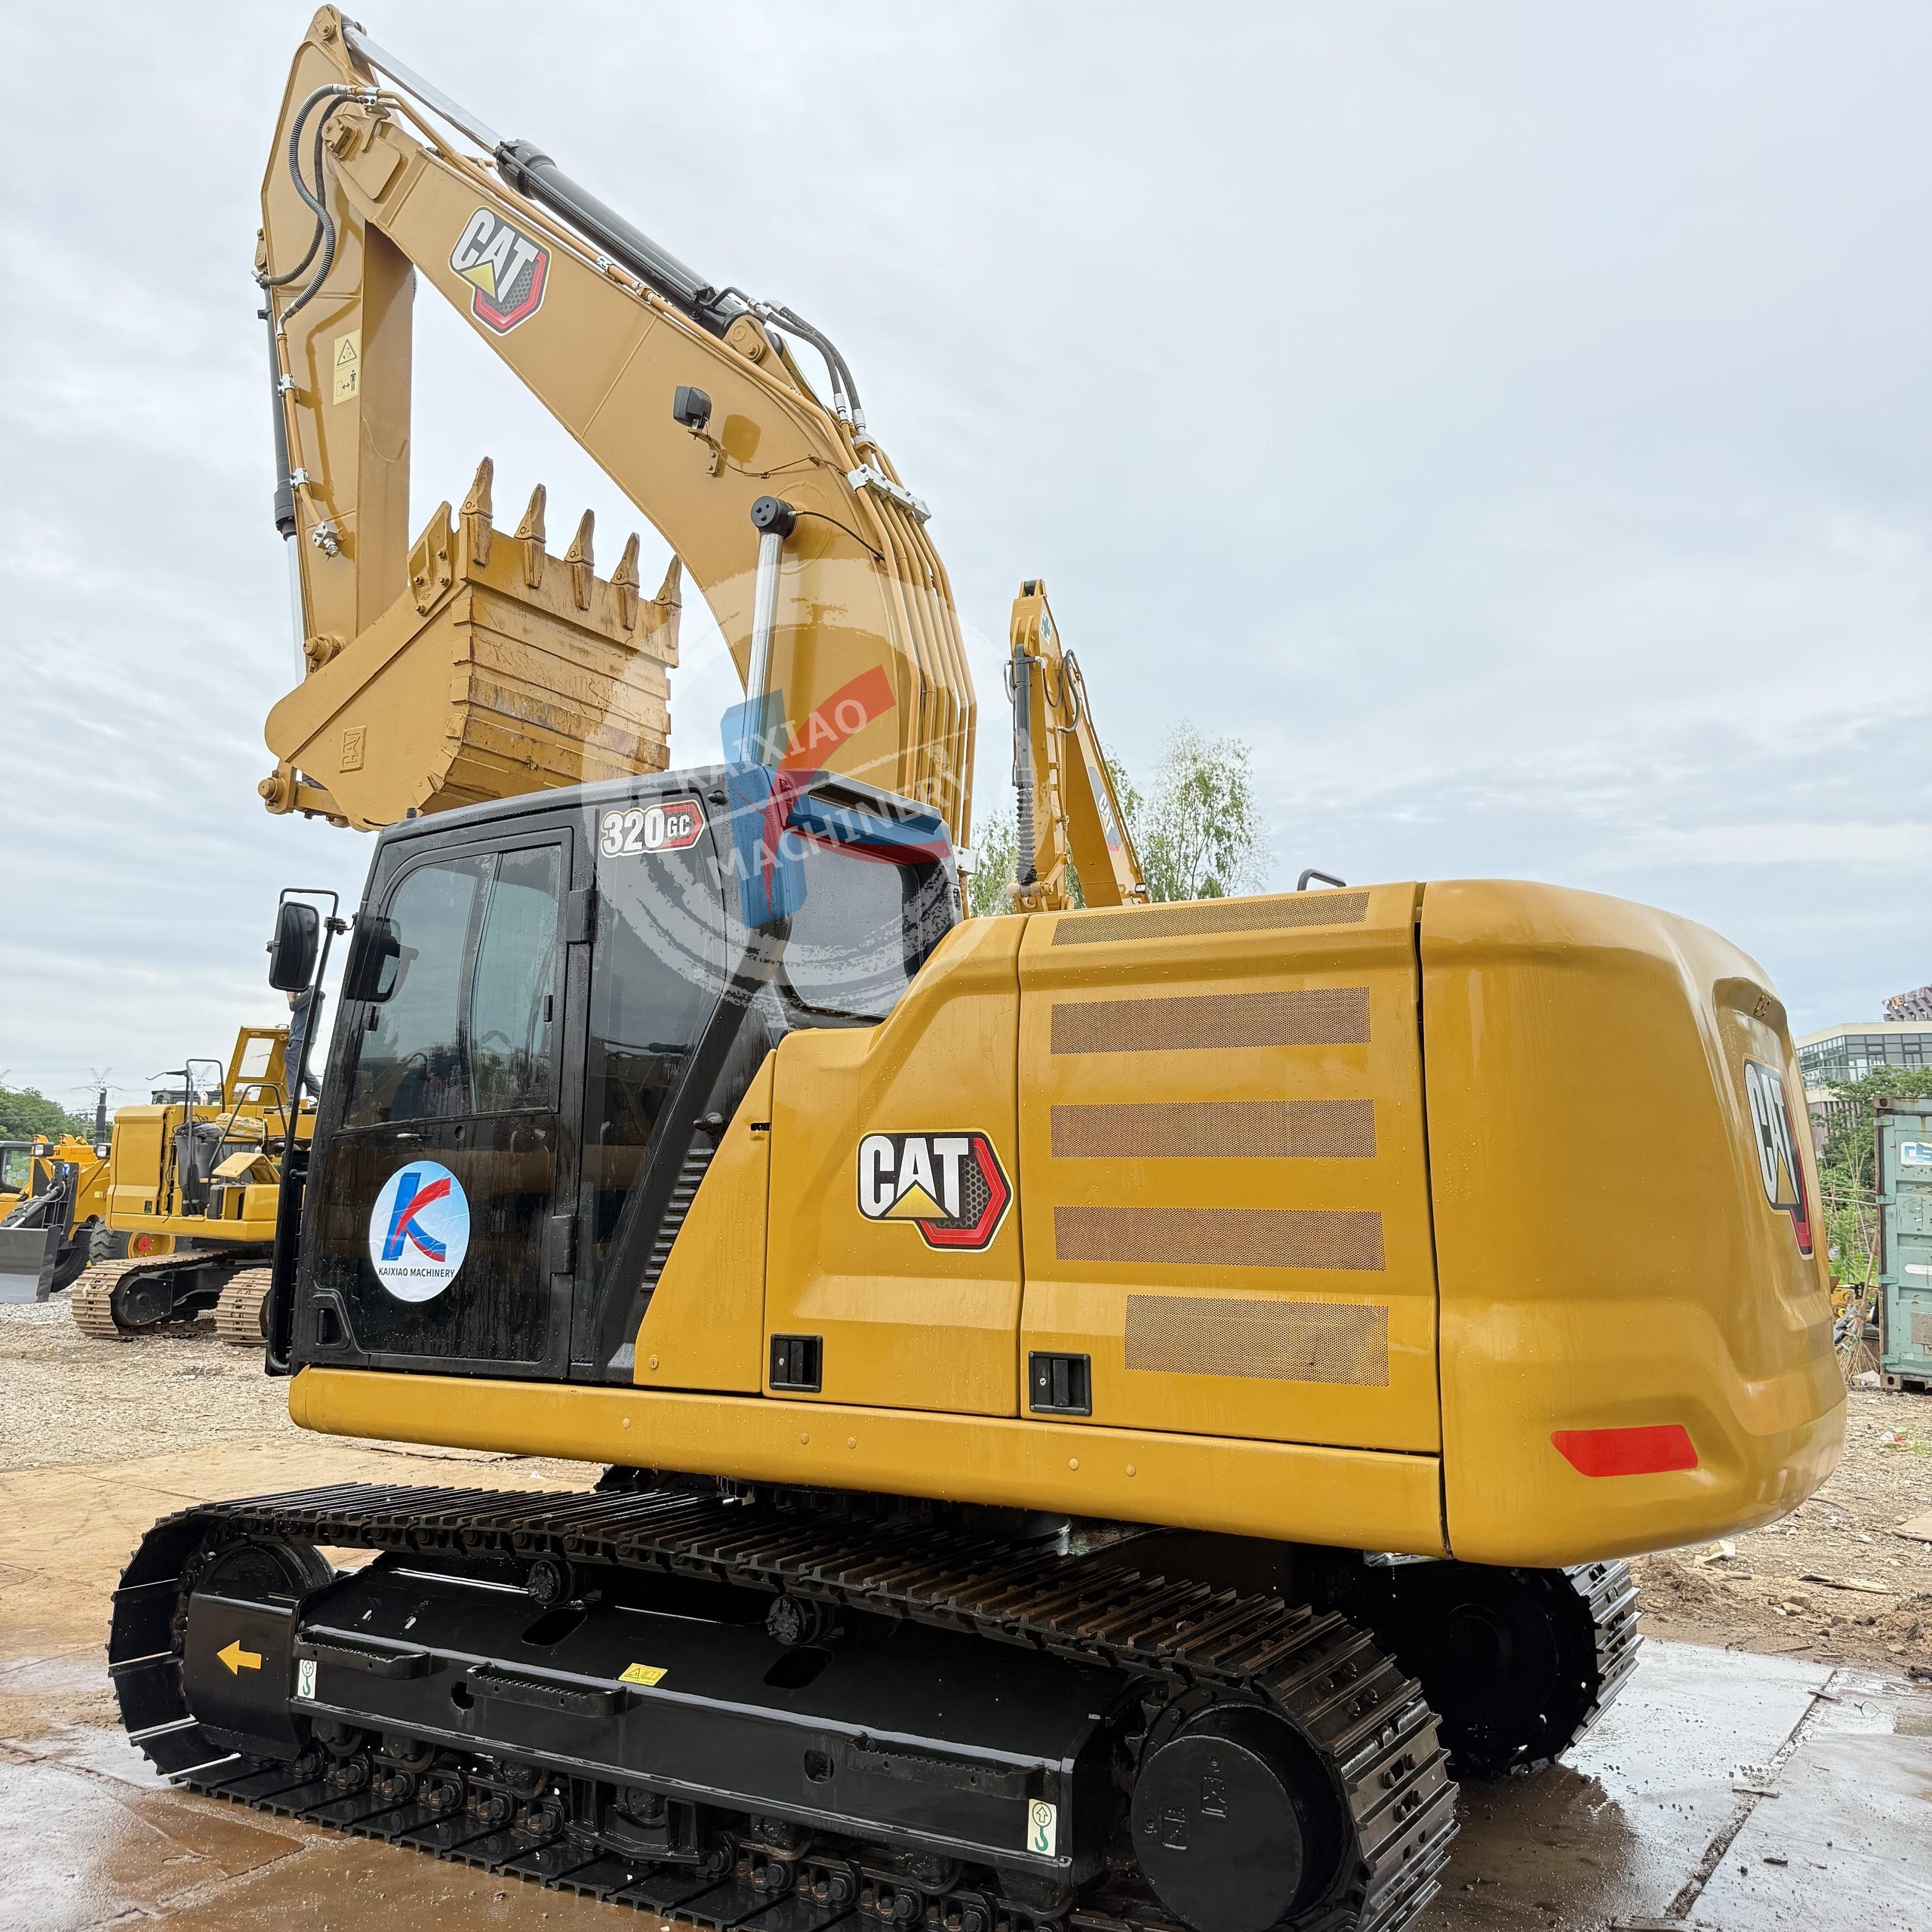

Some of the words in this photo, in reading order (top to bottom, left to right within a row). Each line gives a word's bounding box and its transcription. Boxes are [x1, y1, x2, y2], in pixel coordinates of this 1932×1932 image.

[452, 209, 539, 303] CAT
[342, 732, 361, 768] CAT
[603, 808, 665, 854] 320
[666, 814, 690, 837] GC
[1098, 792, 1115, 836] CAT
[1745, 1063, 1800, 1204] CAT
[860, 1135, 969, 1218] CAT
[378, 1267, 408, 1277] KAIXIAO
[410, 1268, 455, 1278] MACHINERY
